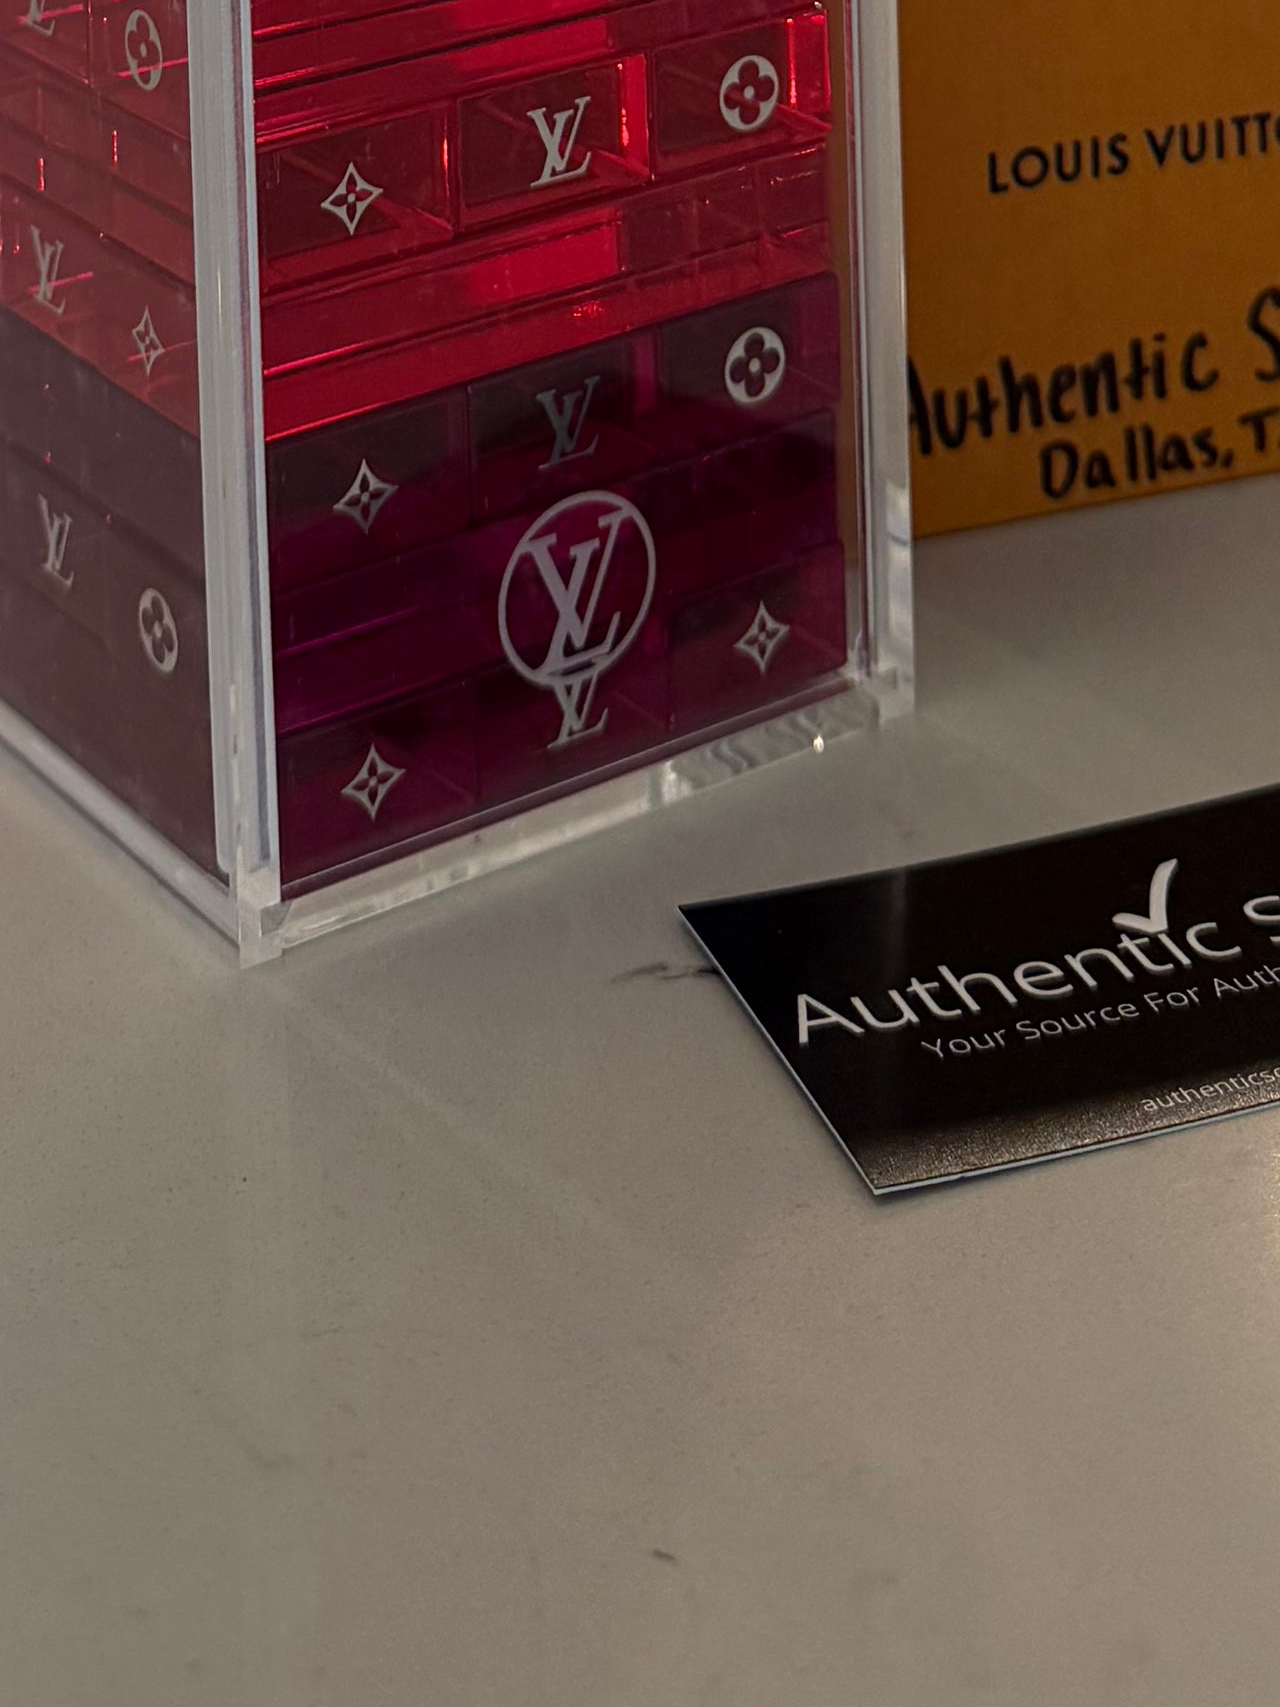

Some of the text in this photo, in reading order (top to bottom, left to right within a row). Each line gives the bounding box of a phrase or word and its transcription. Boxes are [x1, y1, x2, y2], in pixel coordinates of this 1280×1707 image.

[988, 134, 1129, 193] LOUIS
[796, 919, 1243, 1045] Authentic
[922, 1025, 1008, 1060] Your
[1016, 1000, 1139, 1041] Source
[1146, 985, 1200, 1013] For
